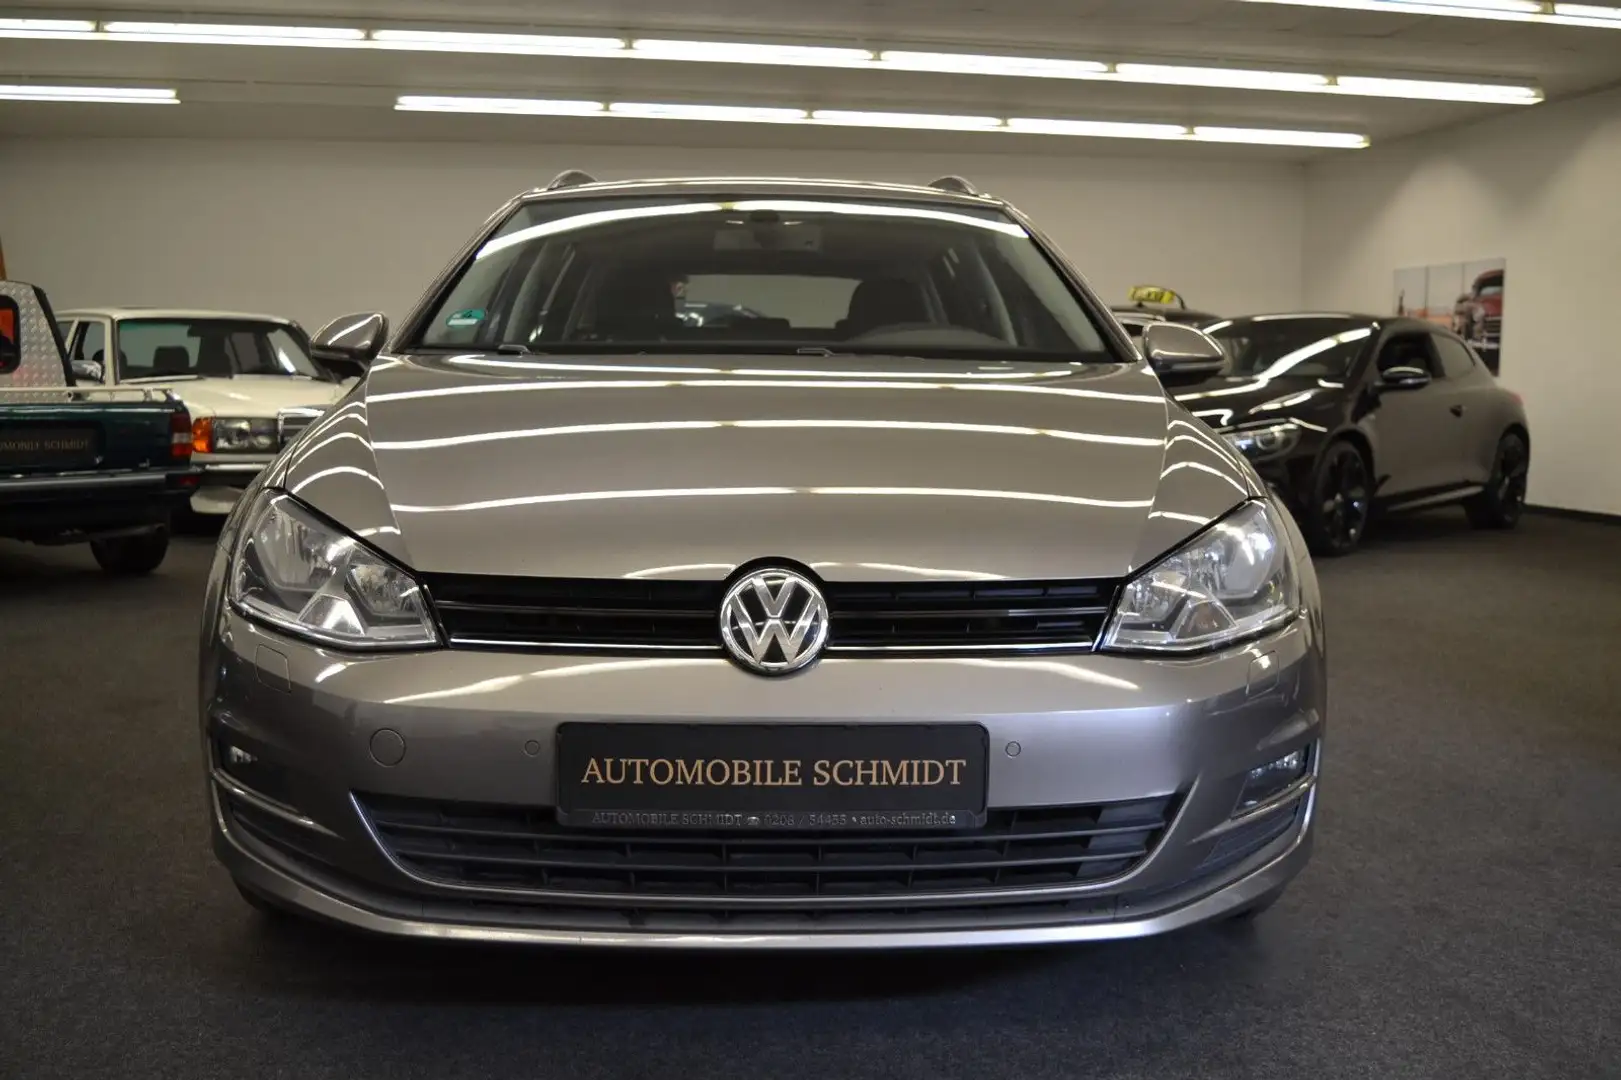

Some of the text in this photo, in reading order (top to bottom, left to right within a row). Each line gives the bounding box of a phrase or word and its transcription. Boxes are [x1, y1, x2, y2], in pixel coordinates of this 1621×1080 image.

[581, 758, 967, 786] AUTOMOBILE SCHMIDT
[592, 812, 680, 825] AUTOMOBILE
